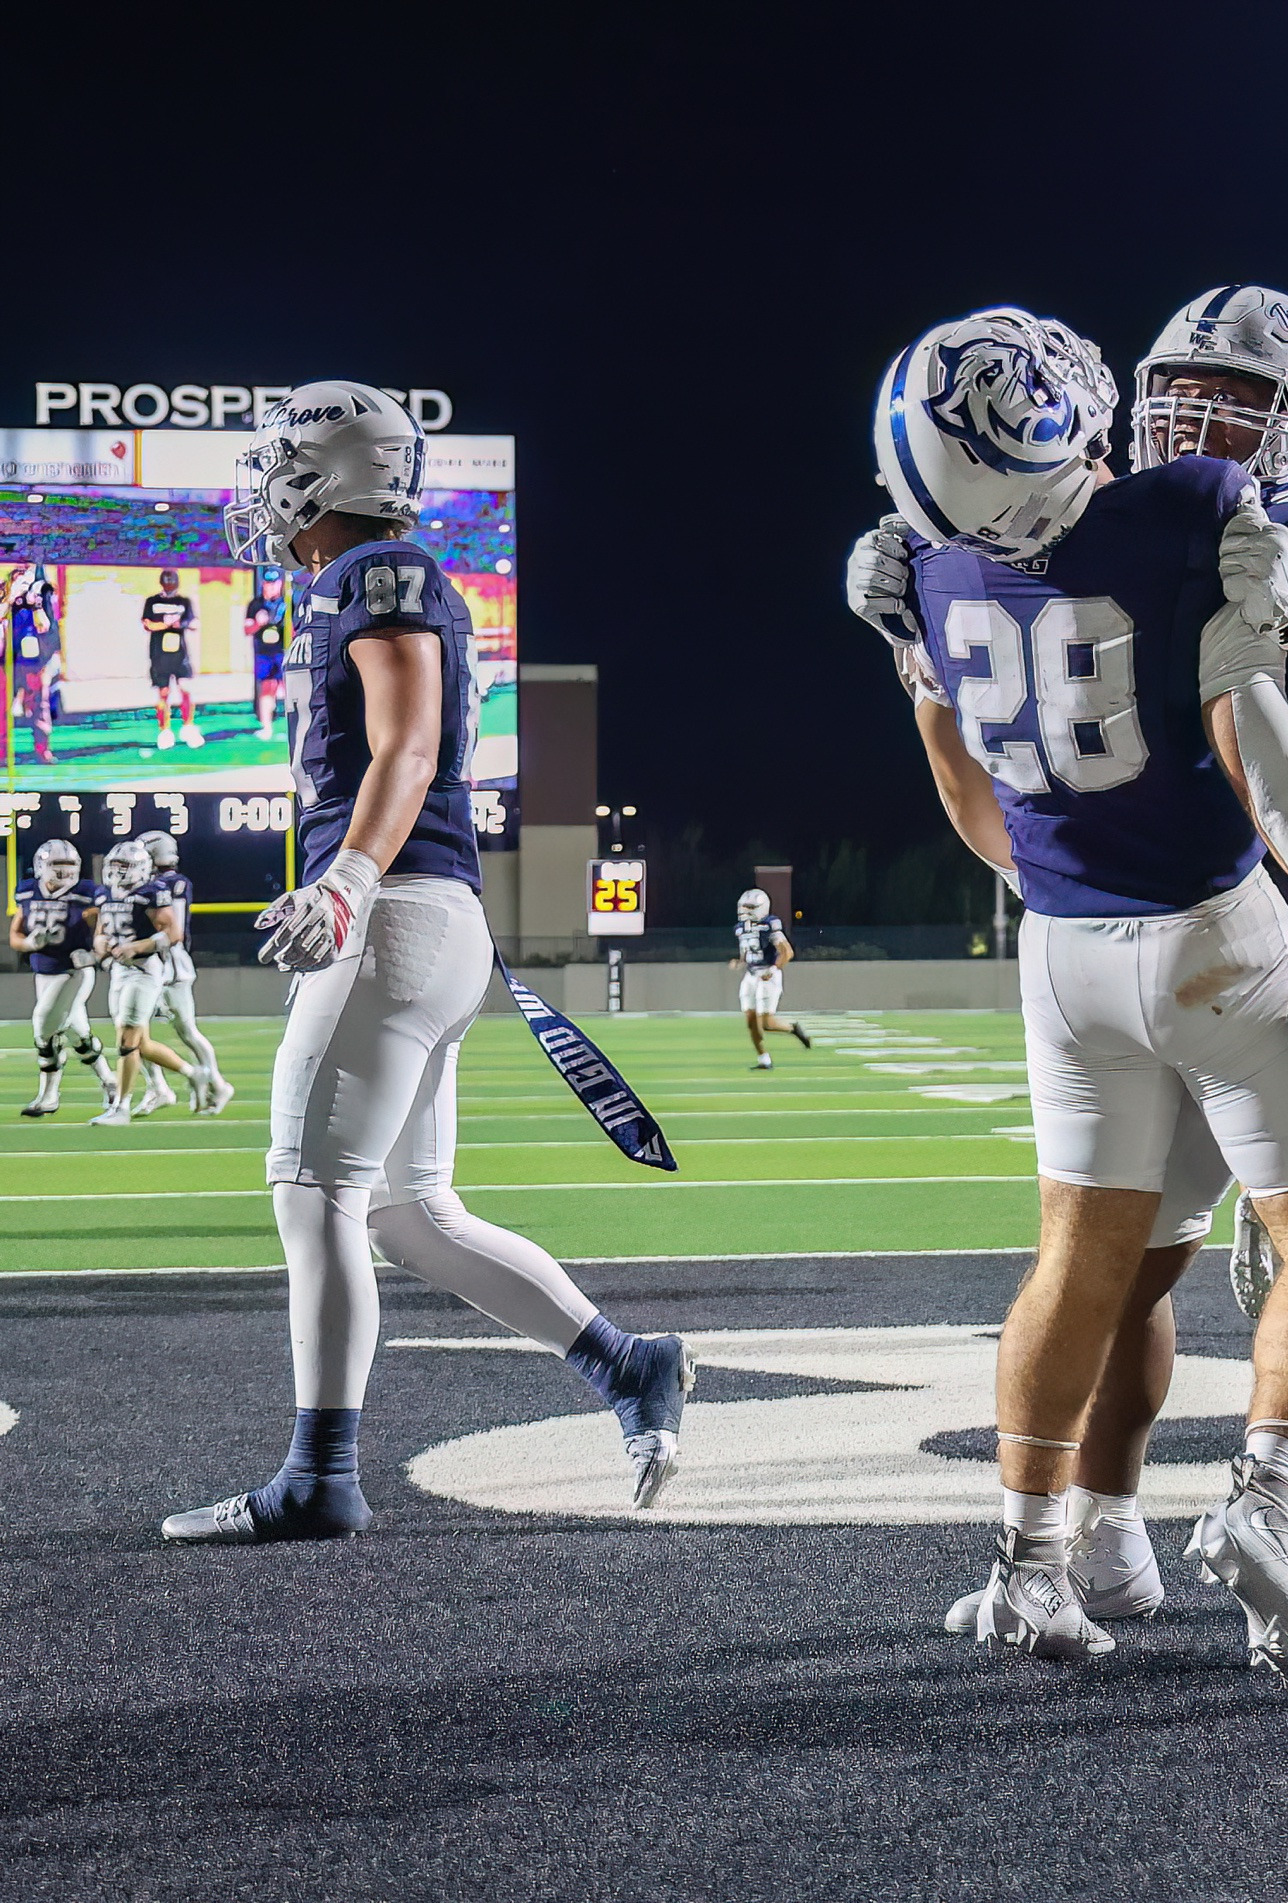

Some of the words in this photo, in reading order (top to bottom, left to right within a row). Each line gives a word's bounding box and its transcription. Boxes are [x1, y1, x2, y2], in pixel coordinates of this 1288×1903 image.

[35, 382, 293, 427] PROSPE
[365, 565, 427, 616] 87
[944, 596, 1151, 795] 28
[219, 797, 292, 831] 0:00
[595, 879, 639, 911] 25
[1023, 1569, 1064, 1618] NIKE
